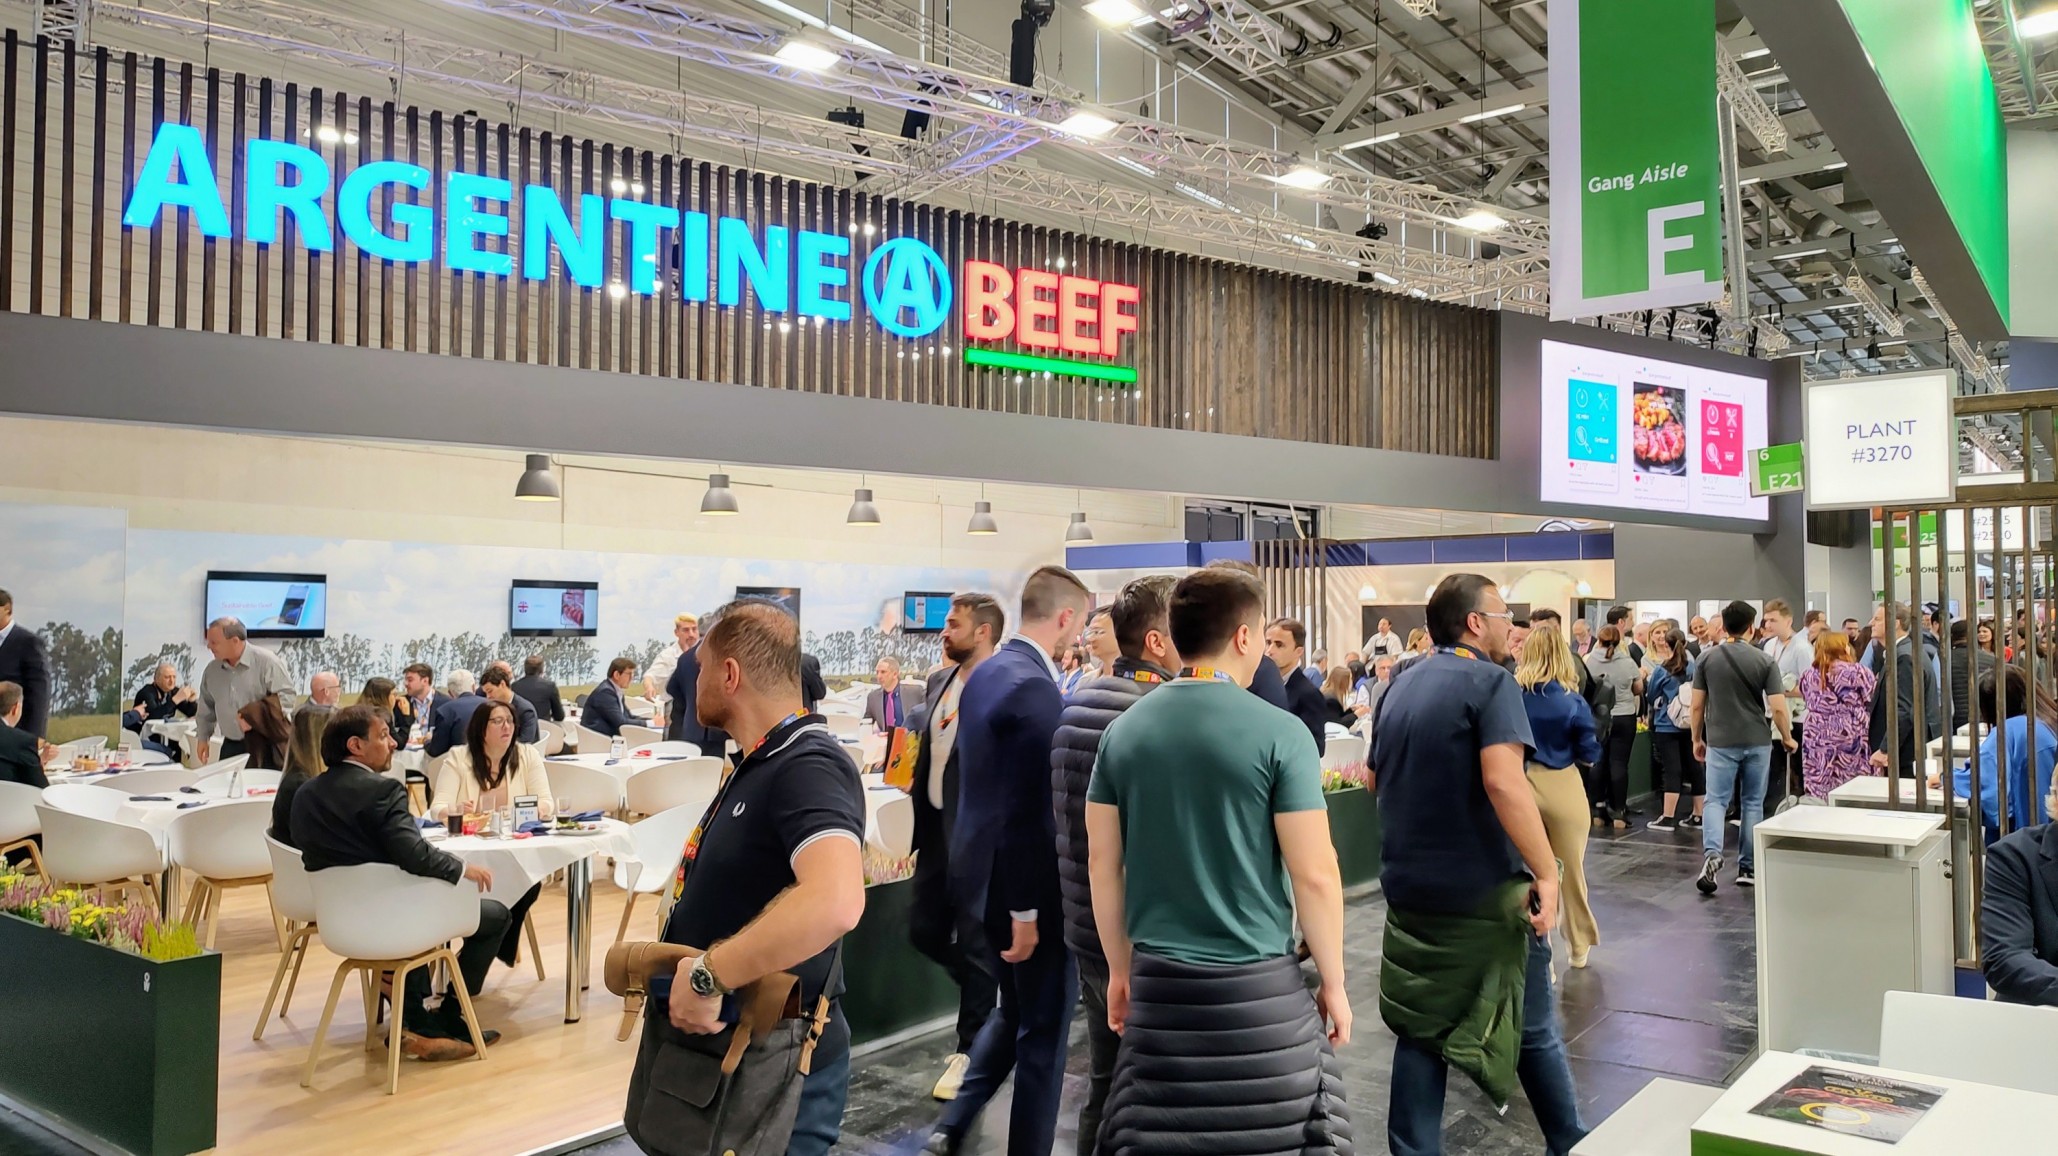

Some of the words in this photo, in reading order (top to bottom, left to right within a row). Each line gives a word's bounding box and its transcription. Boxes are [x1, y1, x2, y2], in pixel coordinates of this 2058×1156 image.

[1588, 173, 1635, 193] Gang
[1639, 162, 1689, 185] Aisle
[122, 121, 851, 322] ARGENTINE
[964, 258, 1140, 358] BEEF
[1647, 200, 1706, 290] E
[1846, 420, 1917, 439] PLANT
[1759, 449, 1770, 461] 6
[1851, 445, 1912, 464] #3270
[1768, 471, 1802, 489] E21
[1973, 515, 2011, 526] #255
[1974, 530, 2012, 541] #250
